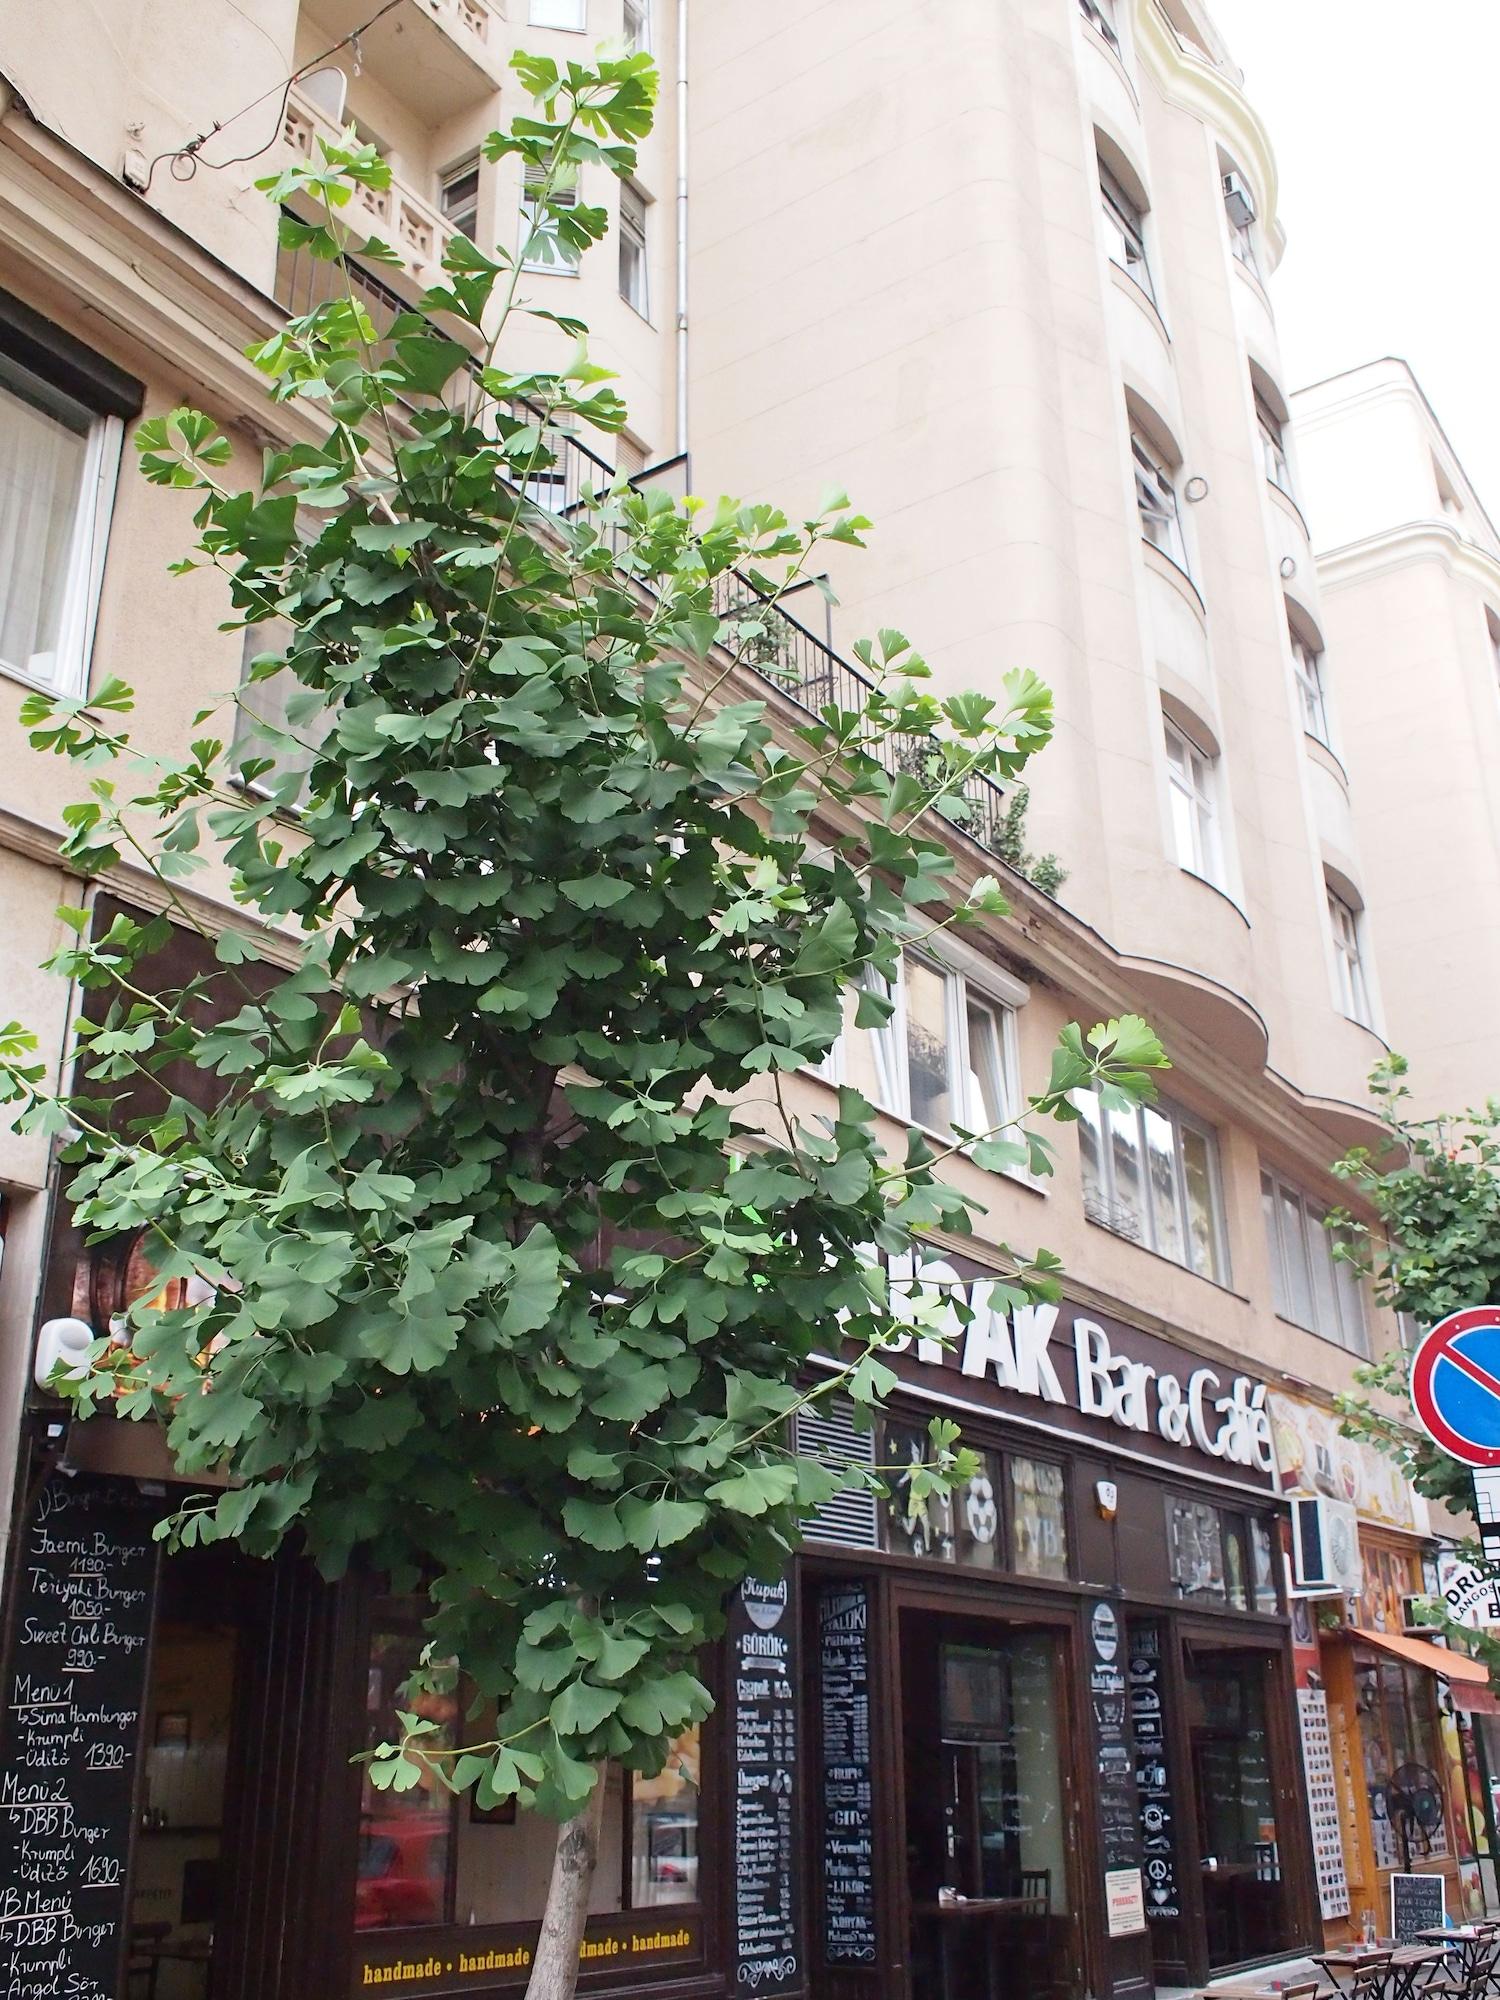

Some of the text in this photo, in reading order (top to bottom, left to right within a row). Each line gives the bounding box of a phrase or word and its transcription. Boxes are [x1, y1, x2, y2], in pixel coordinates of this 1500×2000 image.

[1073, 1318, 1155, 1432] Bar
[90, 1532, 146, 1566] Burger
[95, 1577, 146, 1608] Burger
[20, 1617, 66, 1644] Sweet
[102, 1622, 146, 1654] Burger
[64, 1678, 74, 1700] 1
[69, 1704, 138, 1730] Hamburger
[50, 1777, 69, 1801] 2
[20, 1804, 111, 1845] DBB Burger
[13, 1913, 116, 1948] DBB Burger
[363, 1929, 690, 1985] handmade handmade dmade handmade
[64, 1972, 100, 1994] Sör
